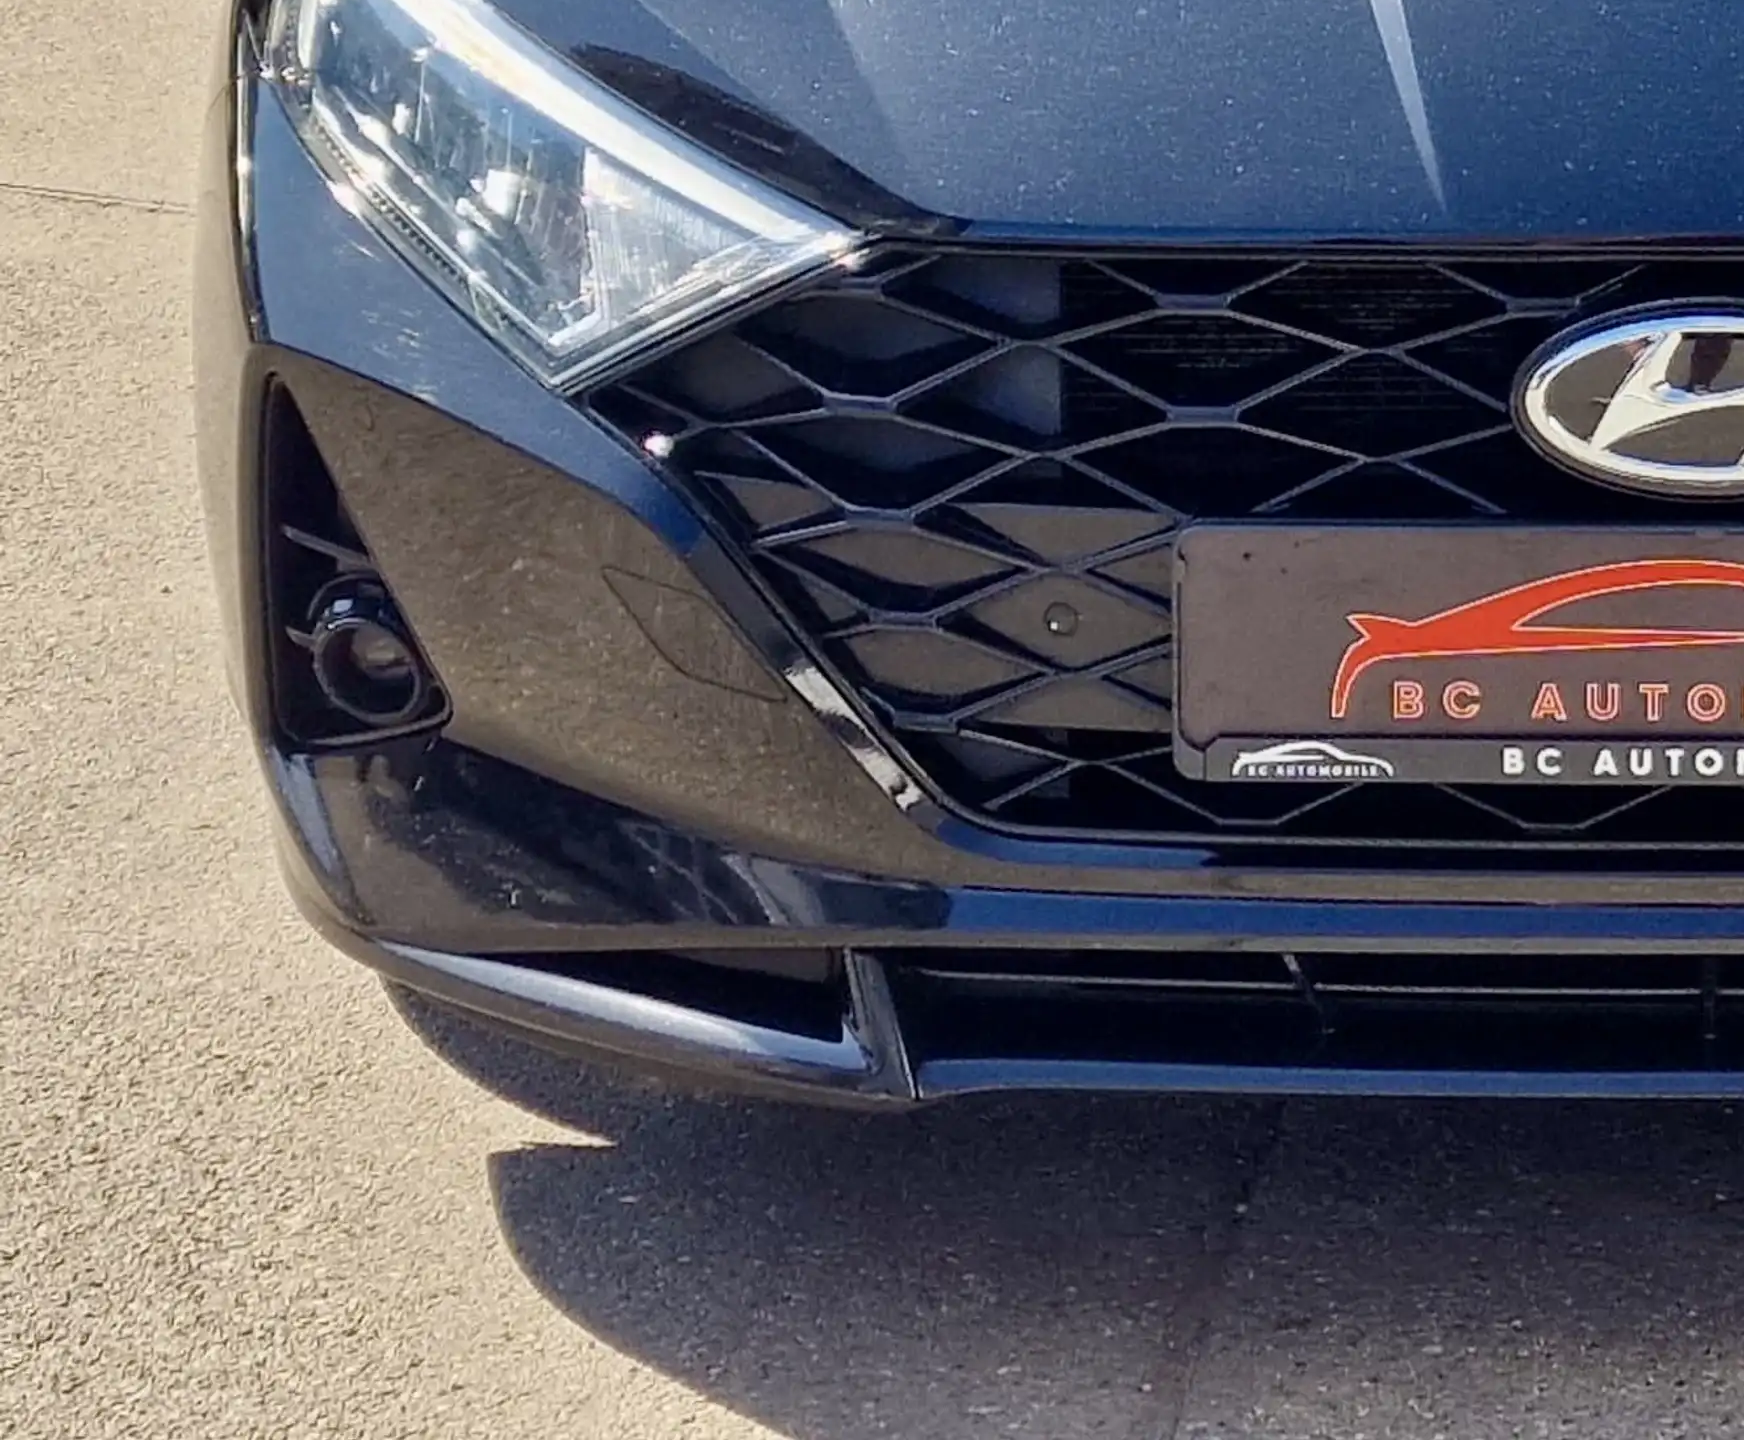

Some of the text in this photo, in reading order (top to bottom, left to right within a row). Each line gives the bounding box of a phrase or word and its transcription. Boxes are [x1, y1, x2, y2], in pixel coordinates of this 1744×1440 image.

[1393, 680, 1481, 720] BC
[1276, 764, 1378, 778] AUTOMOBILE
[1502, 747, 1563, 776] BC
